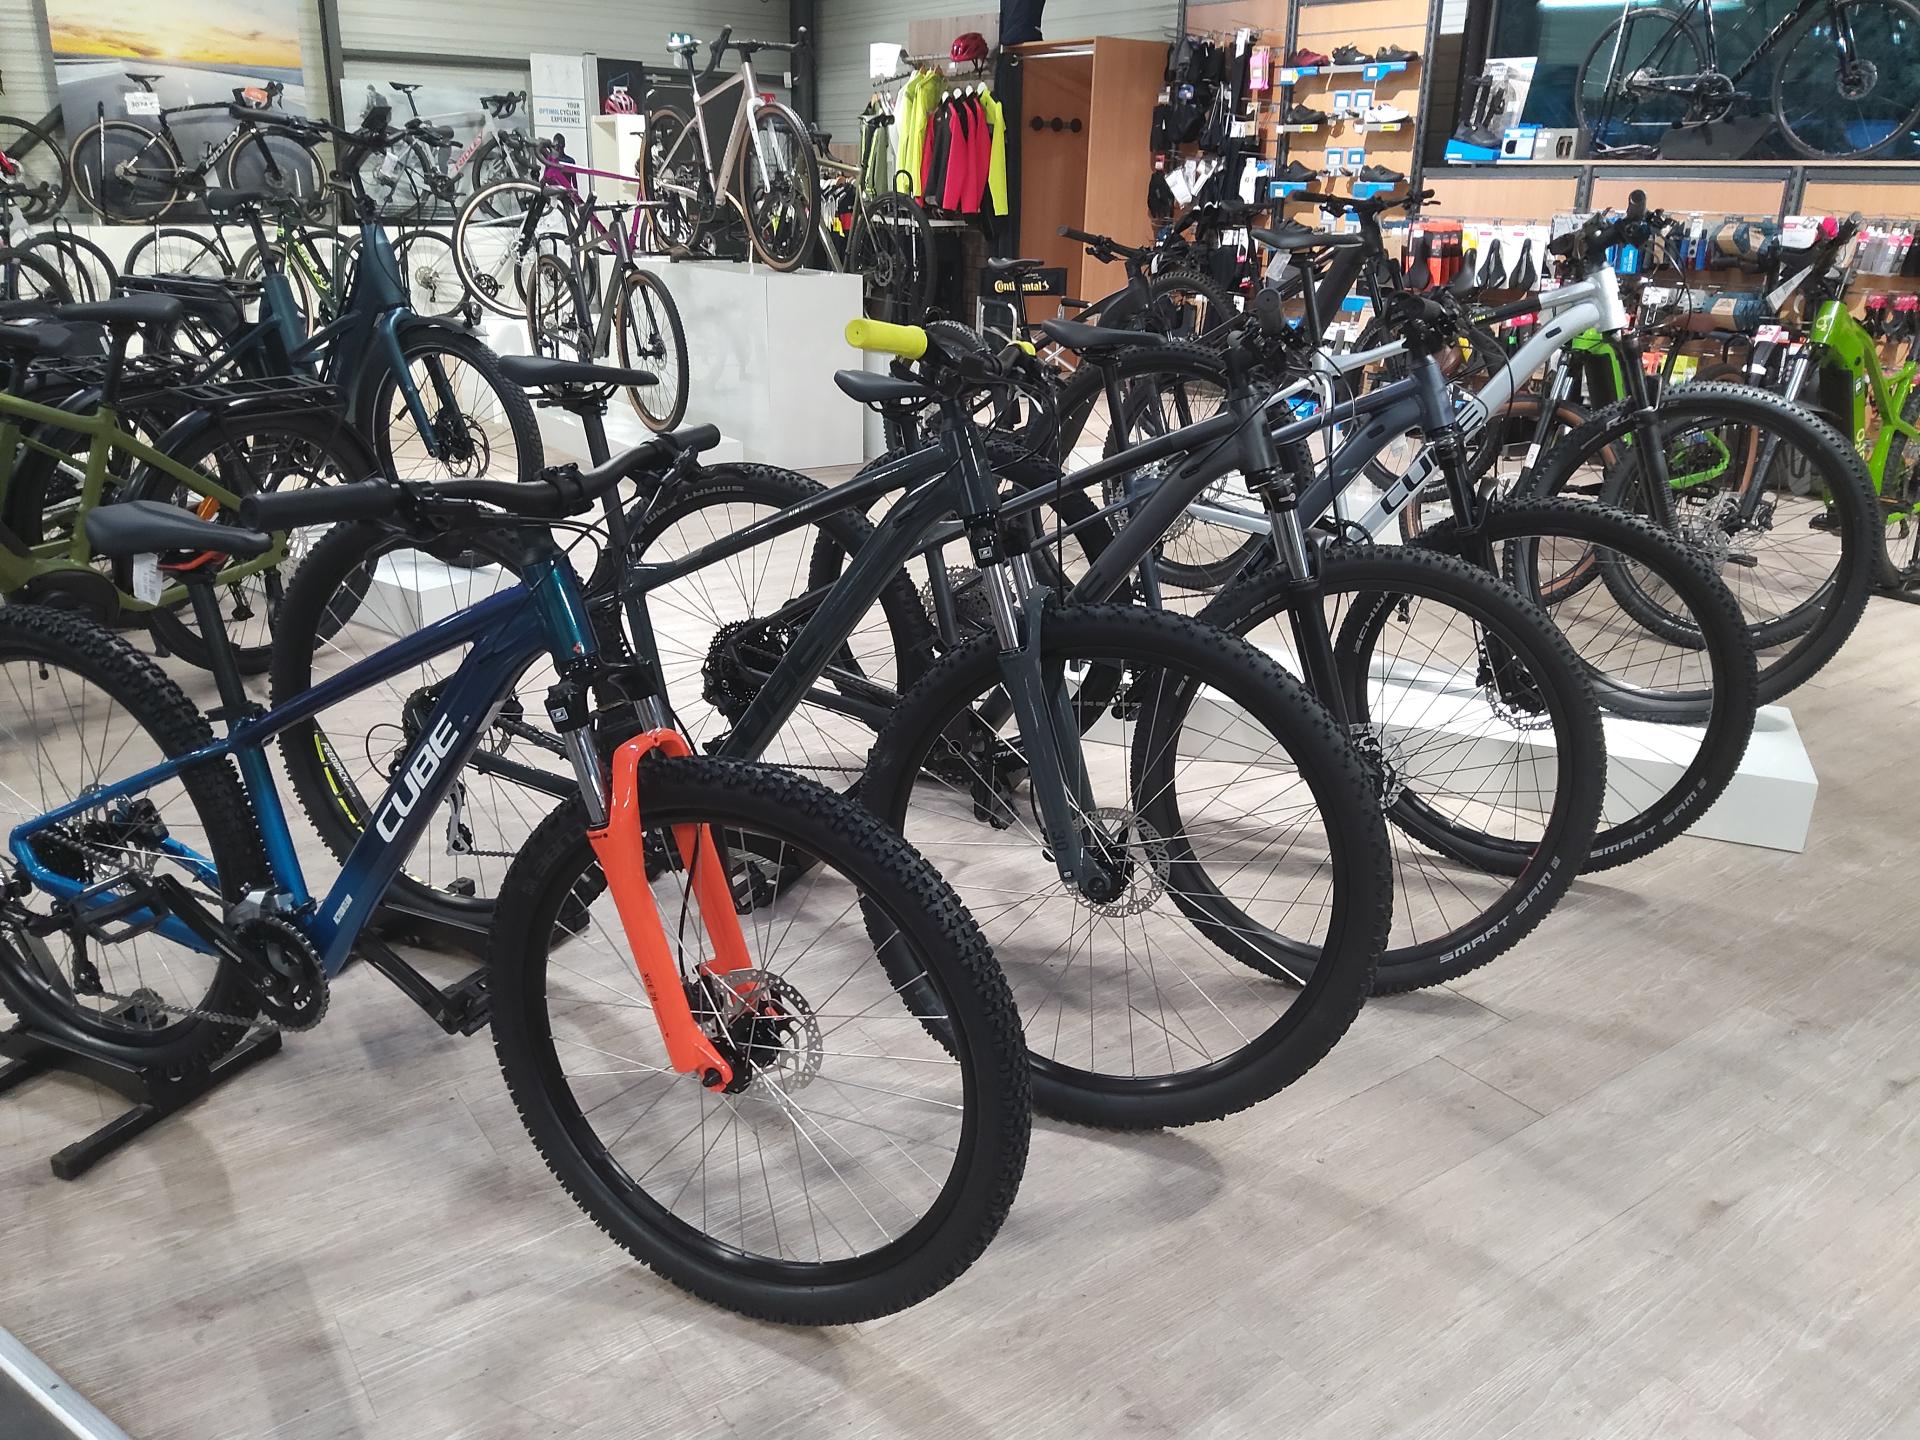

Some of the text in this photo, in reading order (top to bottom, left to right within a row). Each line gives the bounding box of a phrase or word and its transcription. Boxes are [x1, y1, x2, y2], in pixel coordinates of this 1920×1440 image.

[550, 116, 581, 124] EXPERIENCE
[205, 125, 241, 169] RIDLEY
[454, 130, 484, 172] RIDLEY
[994, 280, 1042, 294] Contiental
[1380, 402, 1483, 515] CUE
[321, 742, 351, 783] FEEDBACK
[376, 712, 460, 843] CUBE
[1590, 790, 1698, 859] SMART SAM
[1440, 871, 1552, 964] SMART SAM
